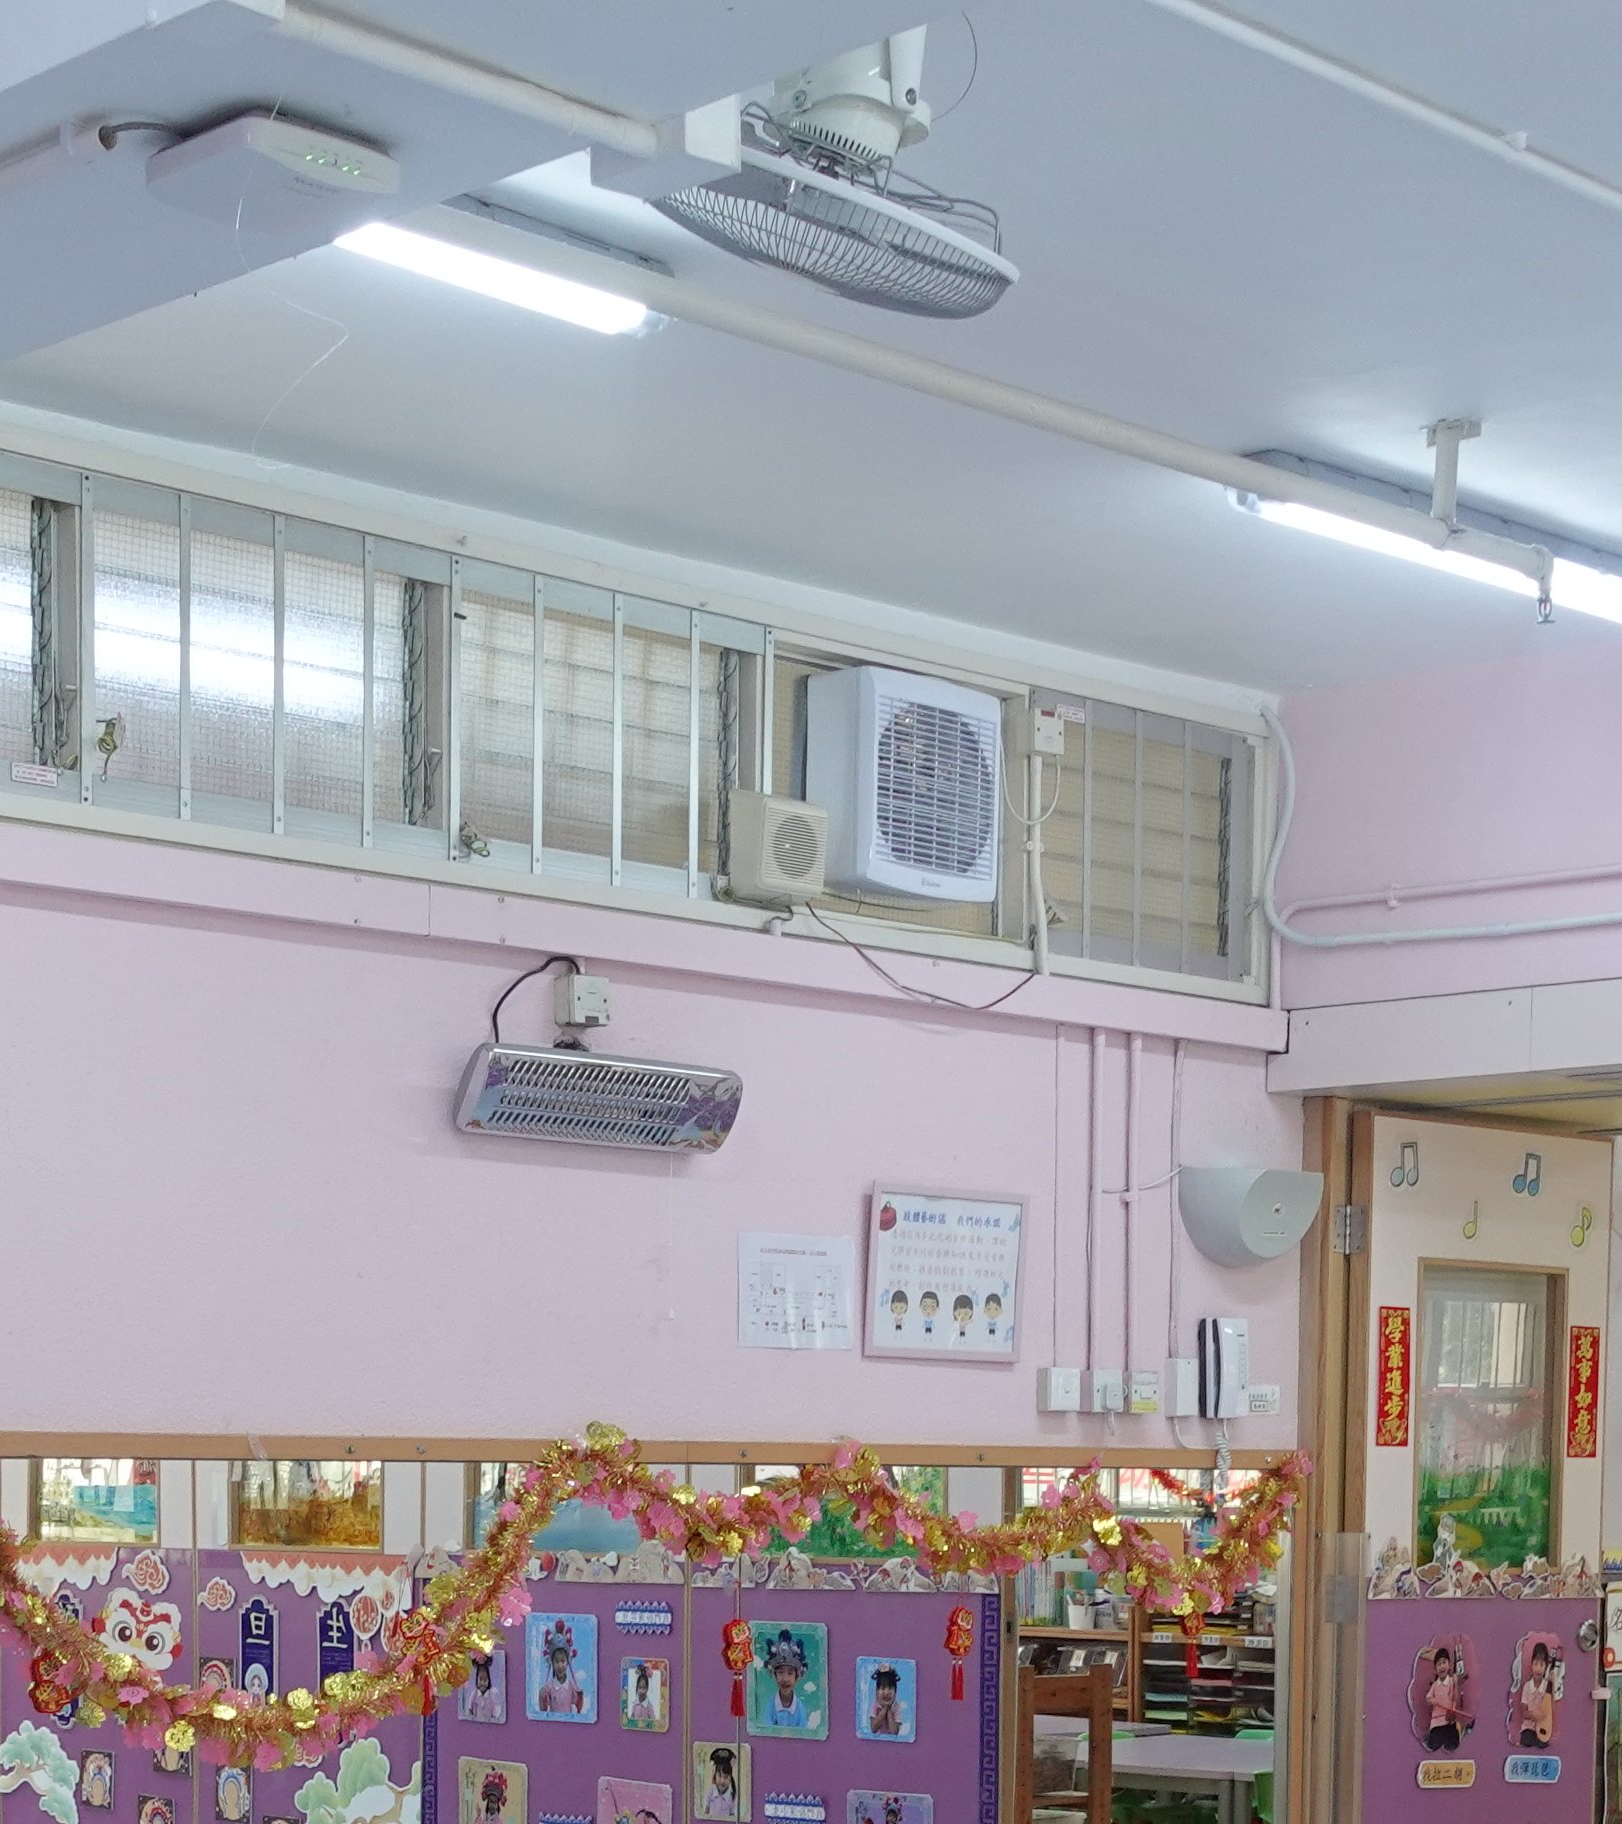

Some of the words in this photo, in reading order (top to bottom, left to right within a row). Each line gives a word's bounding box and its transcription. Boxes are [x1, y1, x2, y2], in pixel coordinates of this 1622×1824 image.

[1384, 1315, 1405, 1421] 學業進步
[1573, 1333, 1595, 1435] 萬事如意
